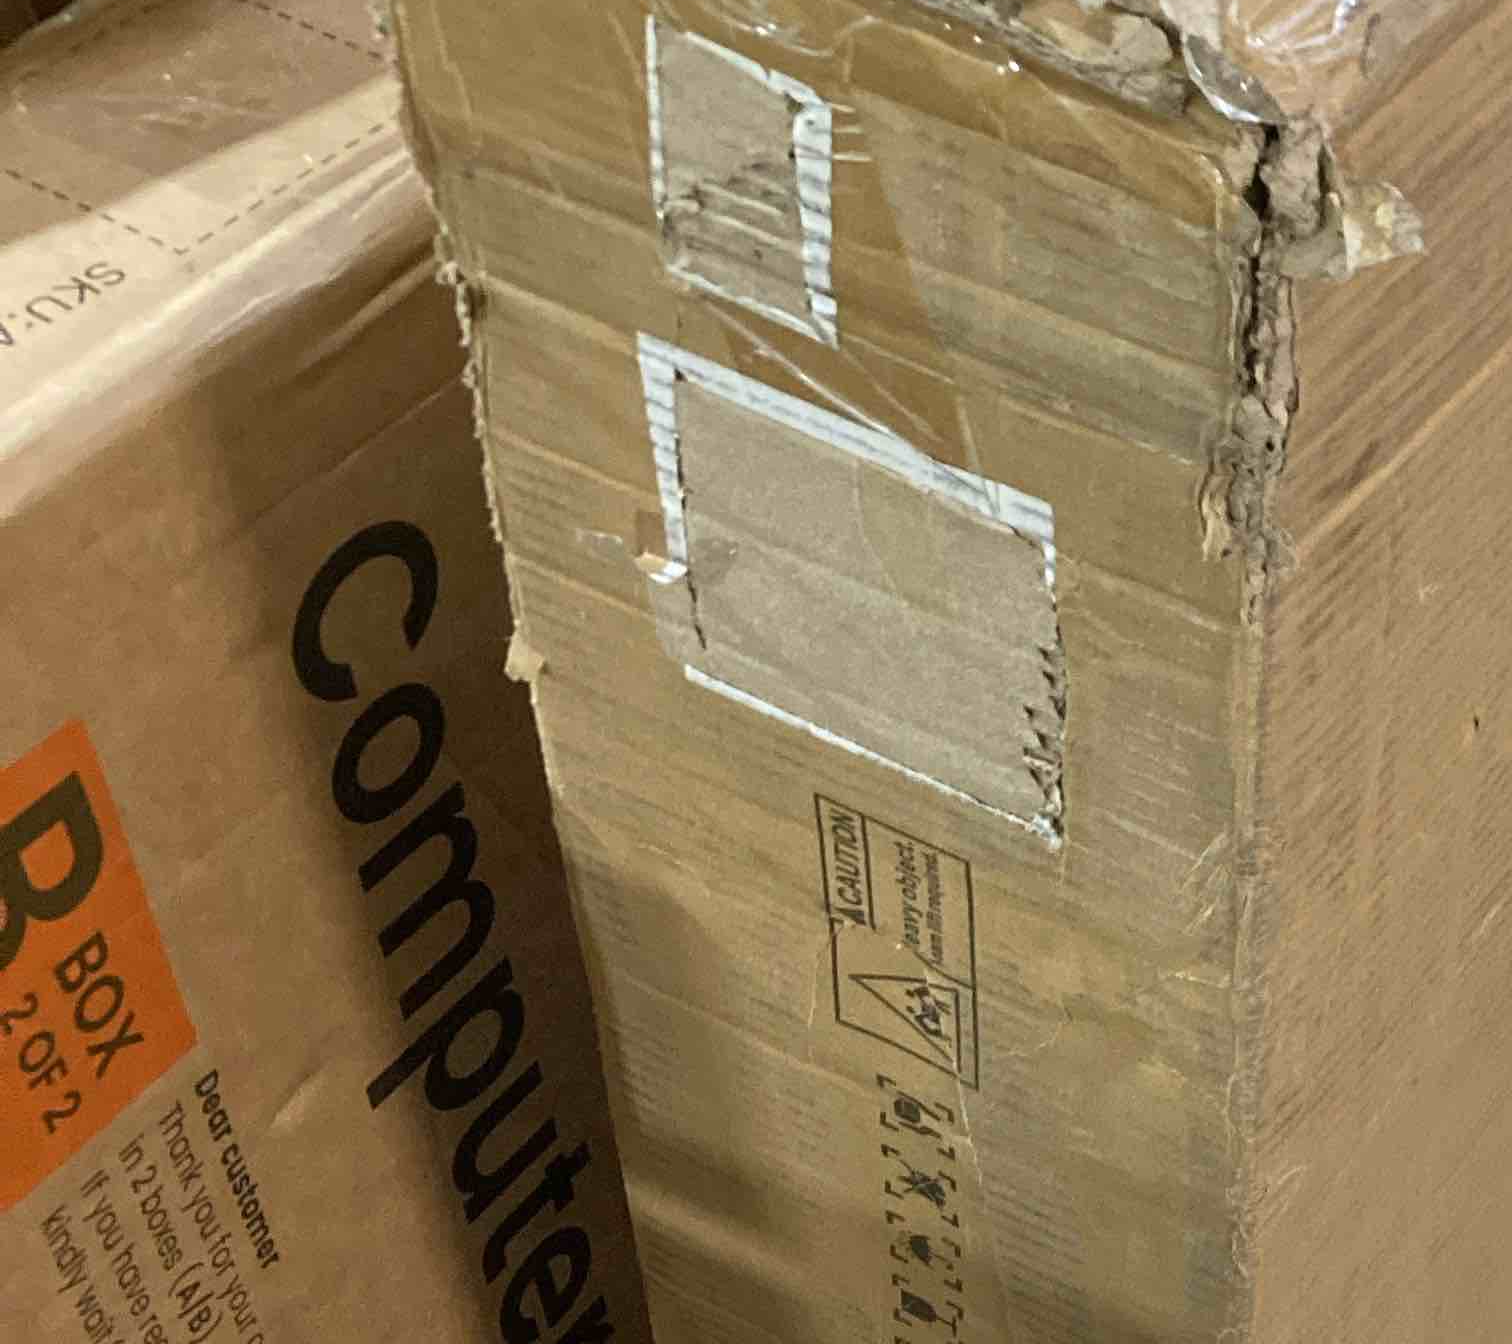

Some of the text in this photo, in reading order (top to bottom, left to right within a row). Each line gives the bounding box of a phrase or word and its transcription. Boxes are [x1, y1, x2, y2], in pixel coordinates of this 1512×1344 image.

[830, 807, 863, 906] CAUTION
[54, 932, 145, 1080] BOX
[0, 992, 82, 1134] 2 OF 2
[78, 1168, 112, 1199] If
[129, 1162, 159, 1195] 2
[156, 1100, 205, 1192] Thank
[193, 1067, 281, 1269] Dear customer
[39, 1203, 89, 1295] kindly
[81, 1193, 126, 1252] you
[138, 1183, 185, 1272] boxes
[179, 1183, 222, 1242] you
[110, 1241, 152, 1317] have
[206, 1230, 238, 1278] for
[214, 1272, 259, 1335] your
